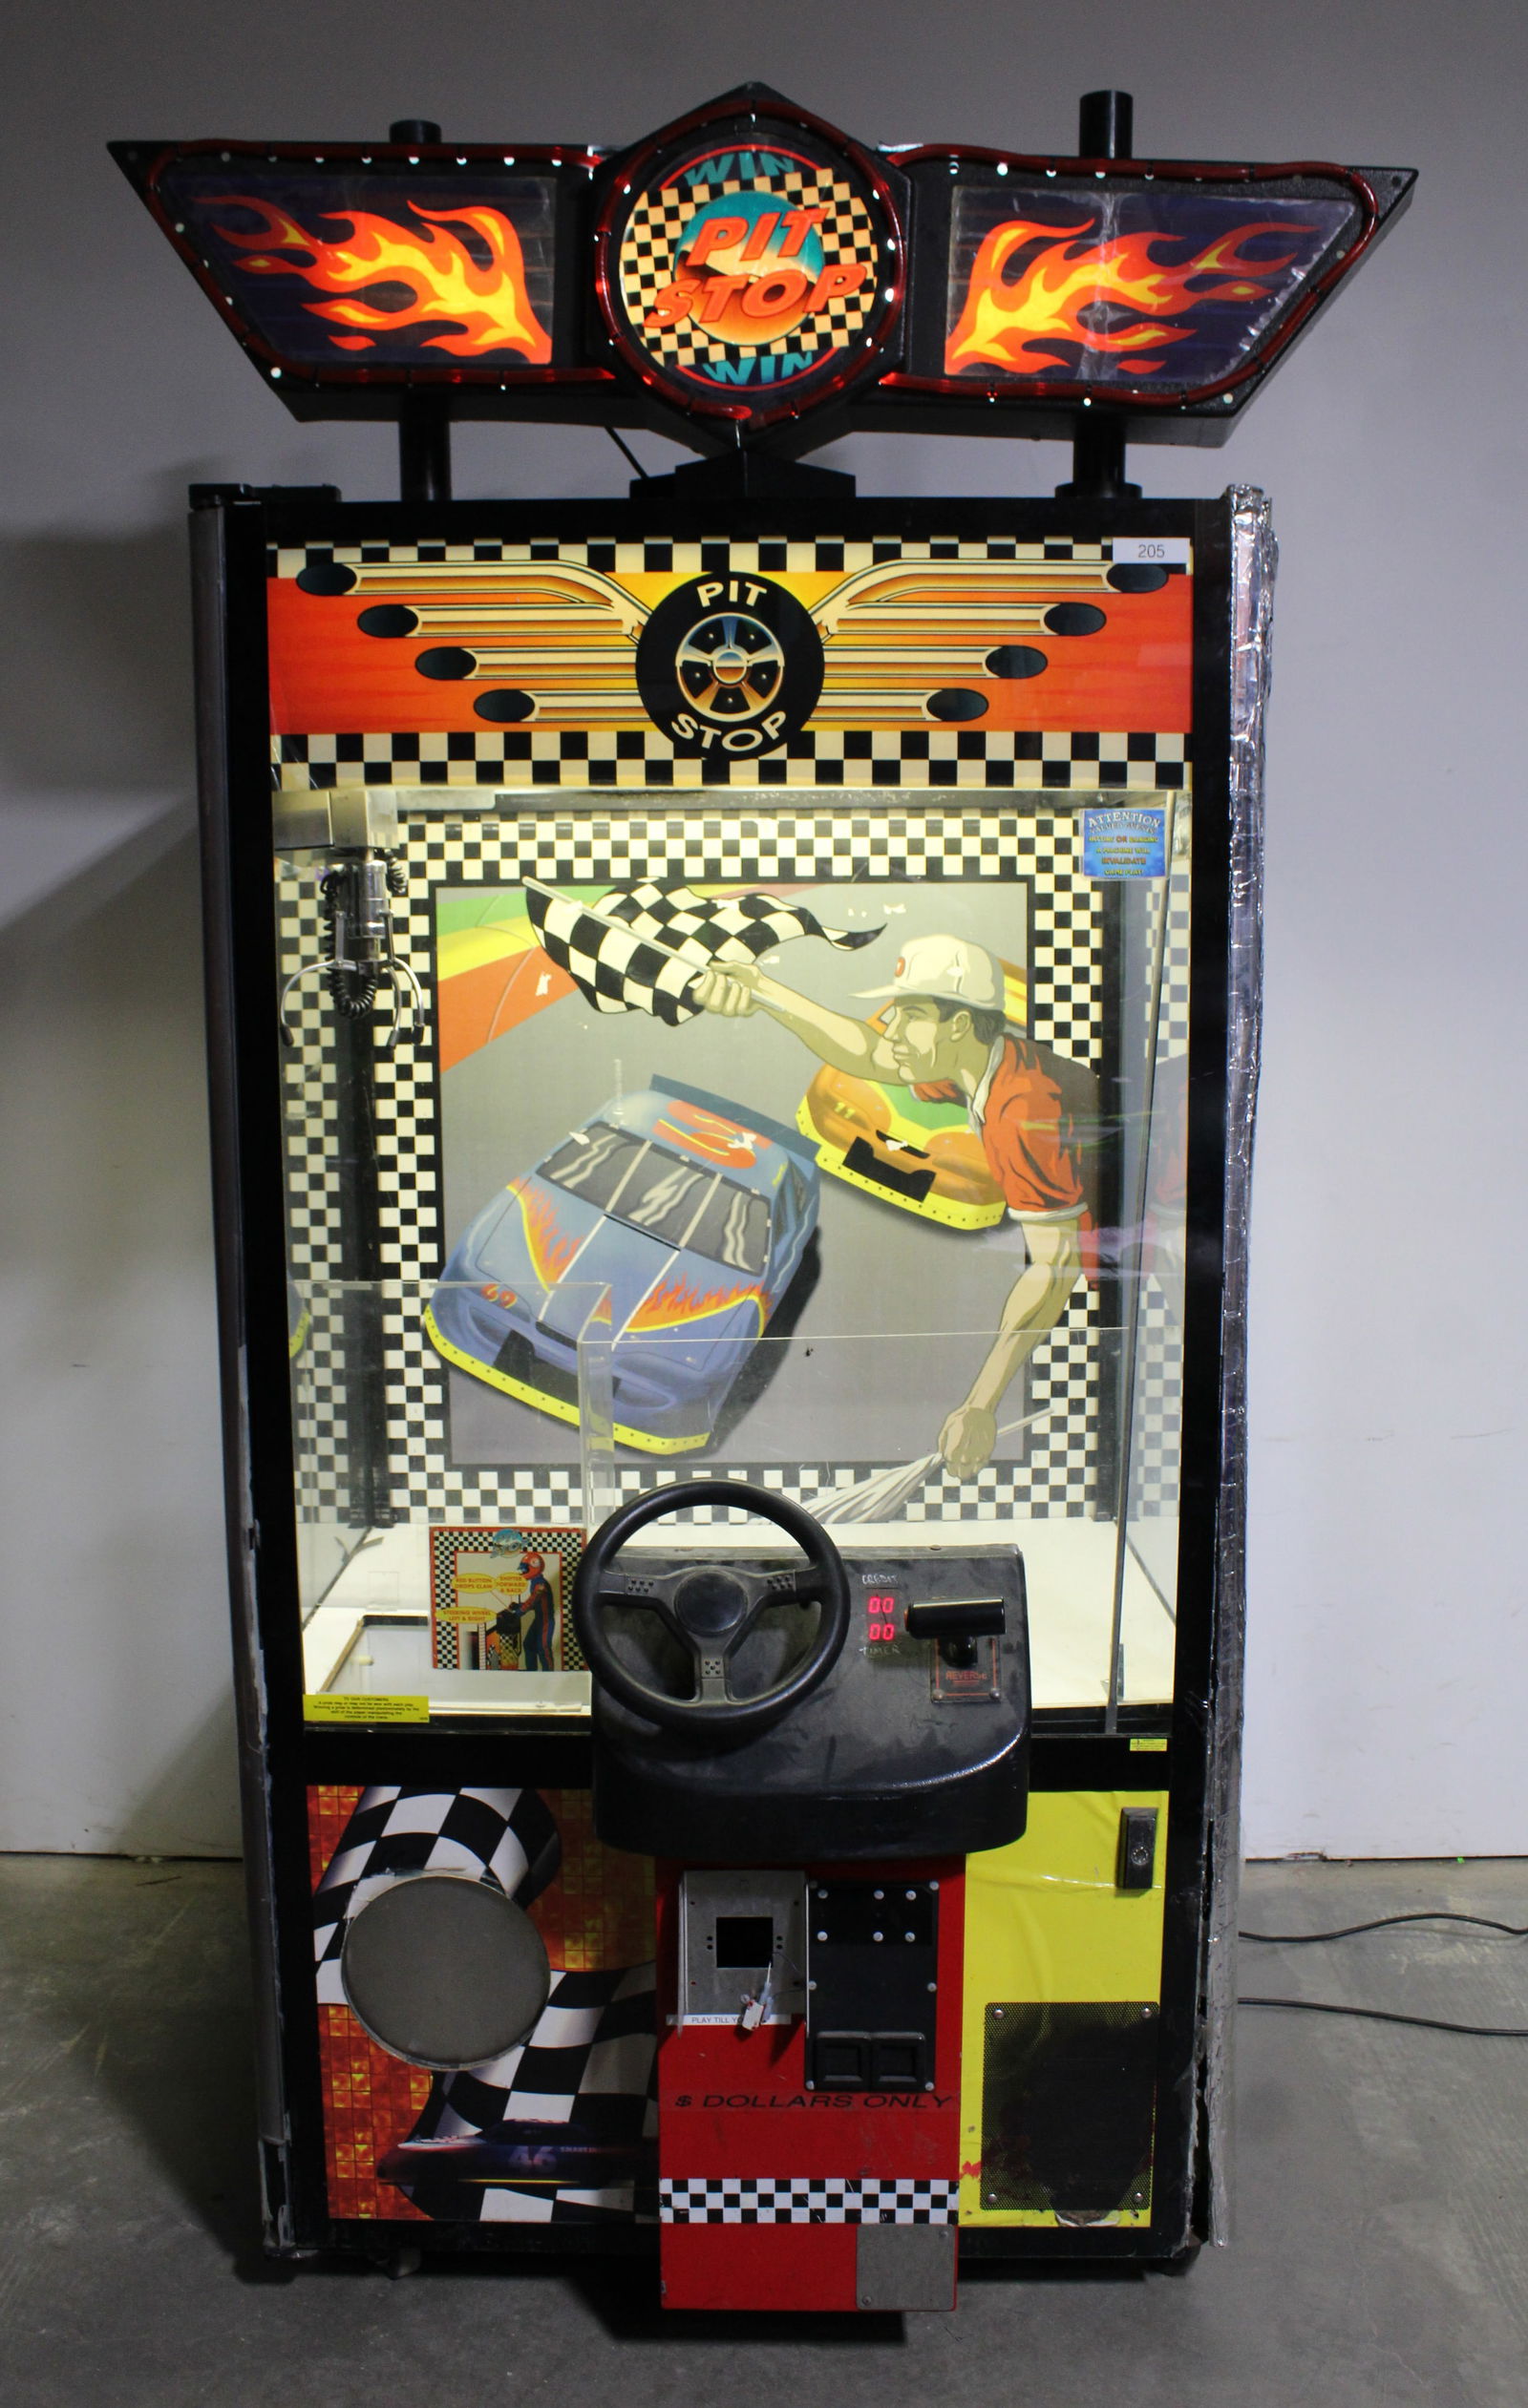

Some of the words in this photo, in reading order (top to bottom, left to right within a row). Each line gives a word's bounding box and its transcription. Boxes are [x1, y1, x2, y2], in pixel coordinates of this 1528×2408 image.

[684, 152, 796, 186] WIN
[686, 207, 830, 266] PIT
[643, 264, 867, 328] STOP
[703, 351, 813, 385] WIN
[1137, 543, 1165, 559] 205
[696, 581, 768, 607] PIT
[671, 710, 787, 752] STOP
[1088, 811, 1161, 828] ATTENTION
[480, 1283, 517, 1309] 69
[861, 1574, 898, 1585] CREDIT
[868, 1595, 894, 1614] 00
[868, 1623, 895, 1640] 00
[859, 1643, 901, 1658] TIMER
[674, 2094, 692, 2107] $
[702, 2094, 852, 2108] DOLLARS
[863, 2094, 953, 2108] ONLY
[509, 2145, 556, 2172] 46
